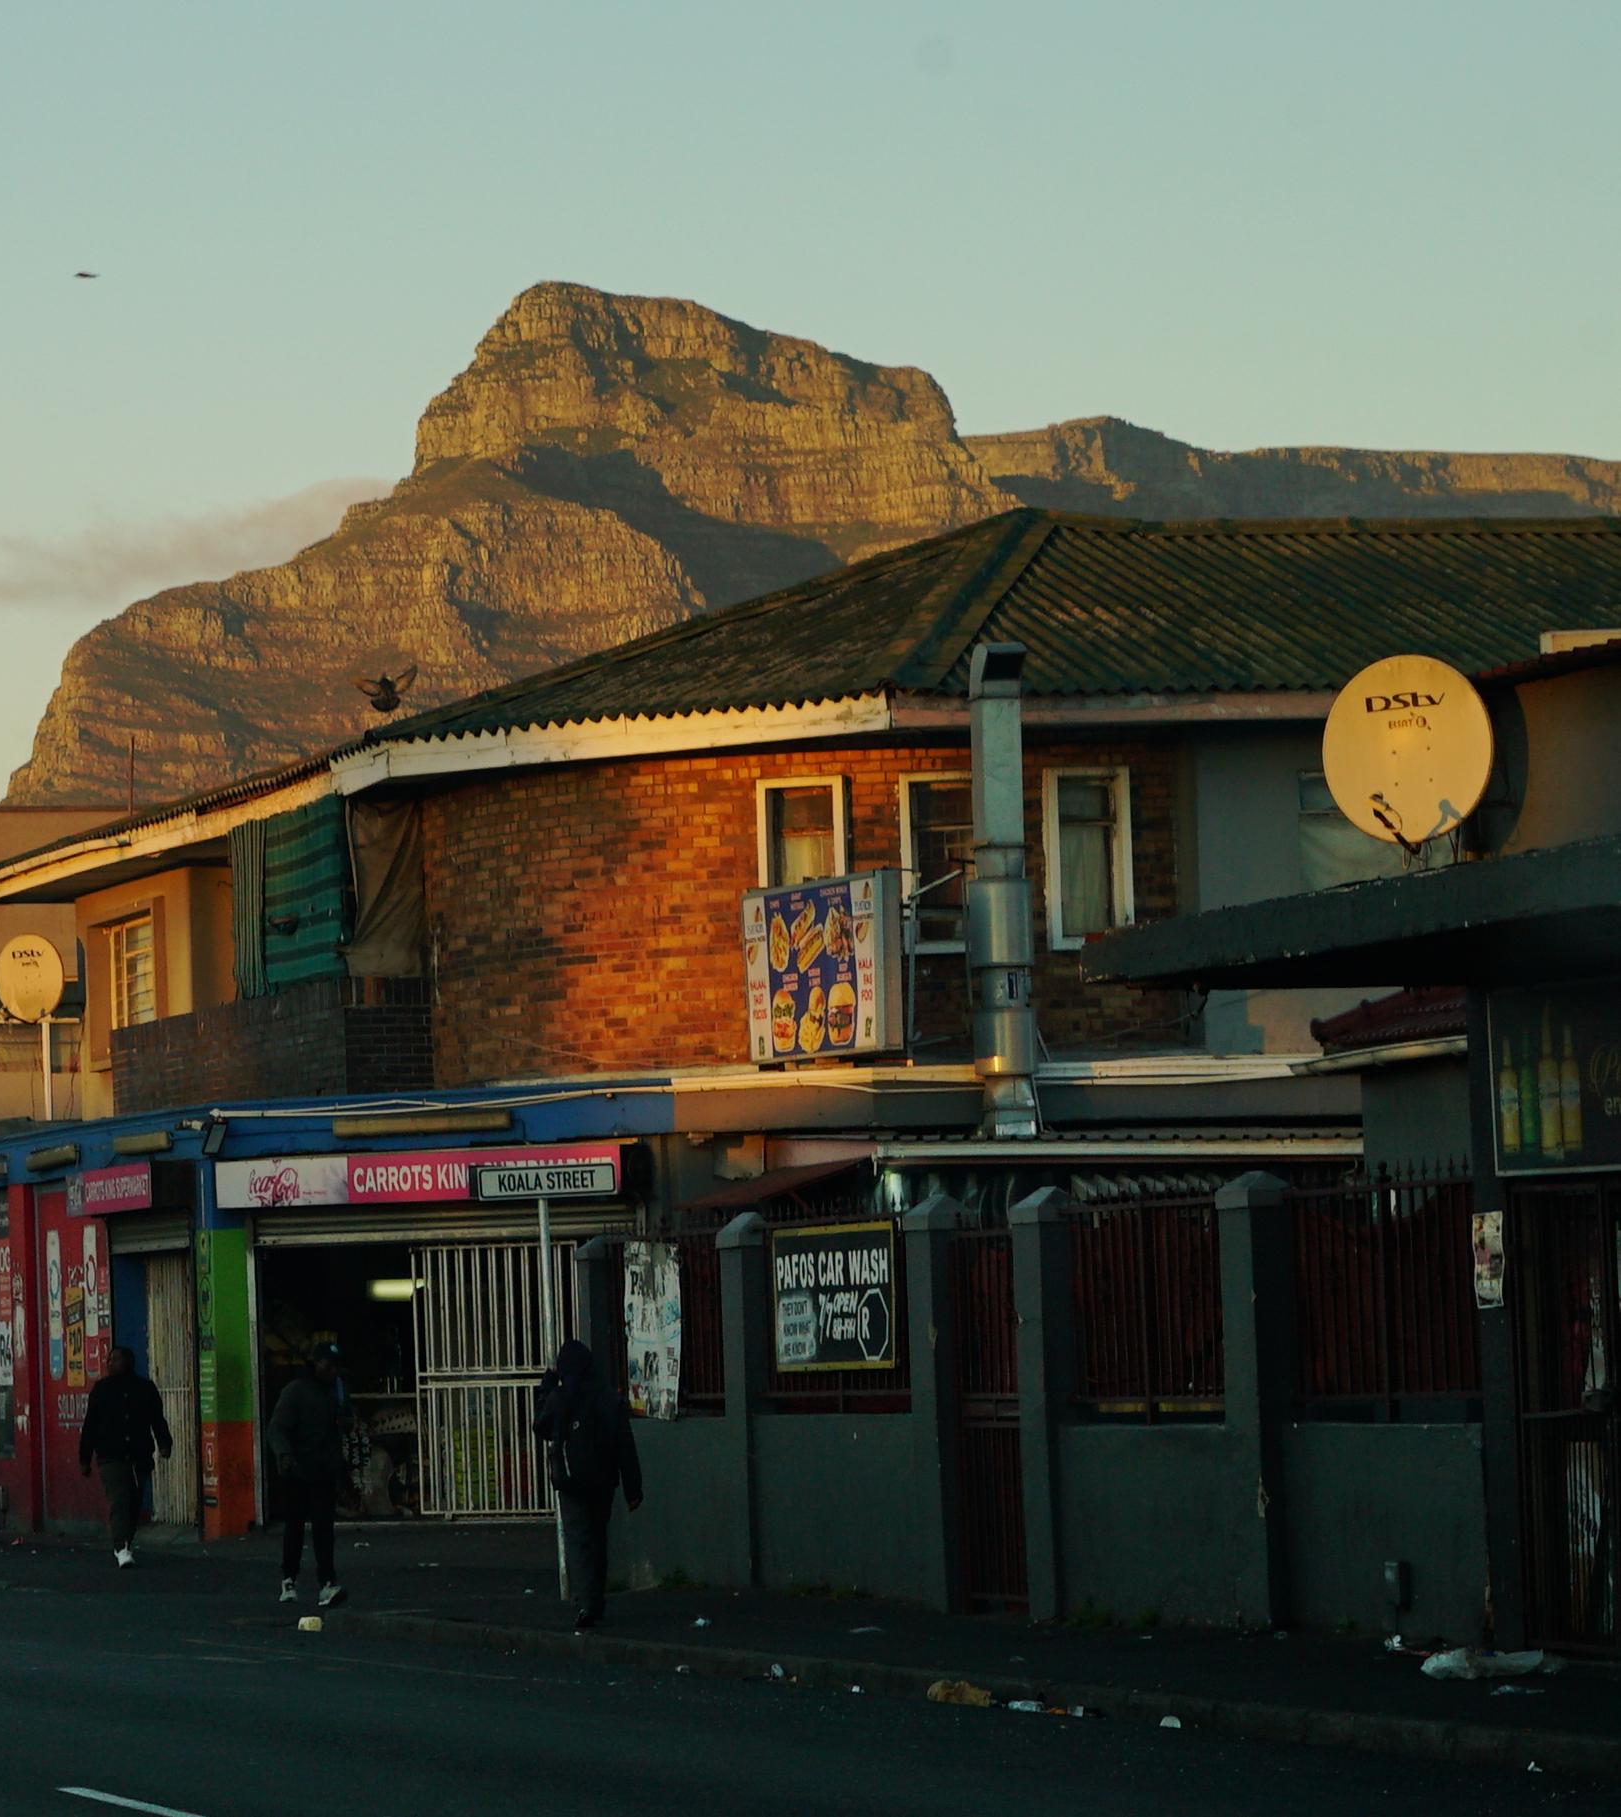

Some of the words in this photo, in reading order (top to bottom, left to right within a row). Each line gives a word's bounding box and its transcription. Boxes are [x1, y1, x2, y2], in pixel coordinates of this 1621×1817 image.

[1365, 692, 1445, 713] DStv
[353, 1165, 433, 1194] CARROTS
[436, 1161, 476, 1190] KIN
[498, 1171, 543, 1192] KOALA
[546, 1169, 596, 1190] STREET
[777, 1252, 816, 1291] PAFOS
[818, 1251, 845, 1287] CAR
[848, 1248, 889, 1285] WASH
[833, 1290, 858, 1314] OPEN
[861, 1306, 870, 1340] R
